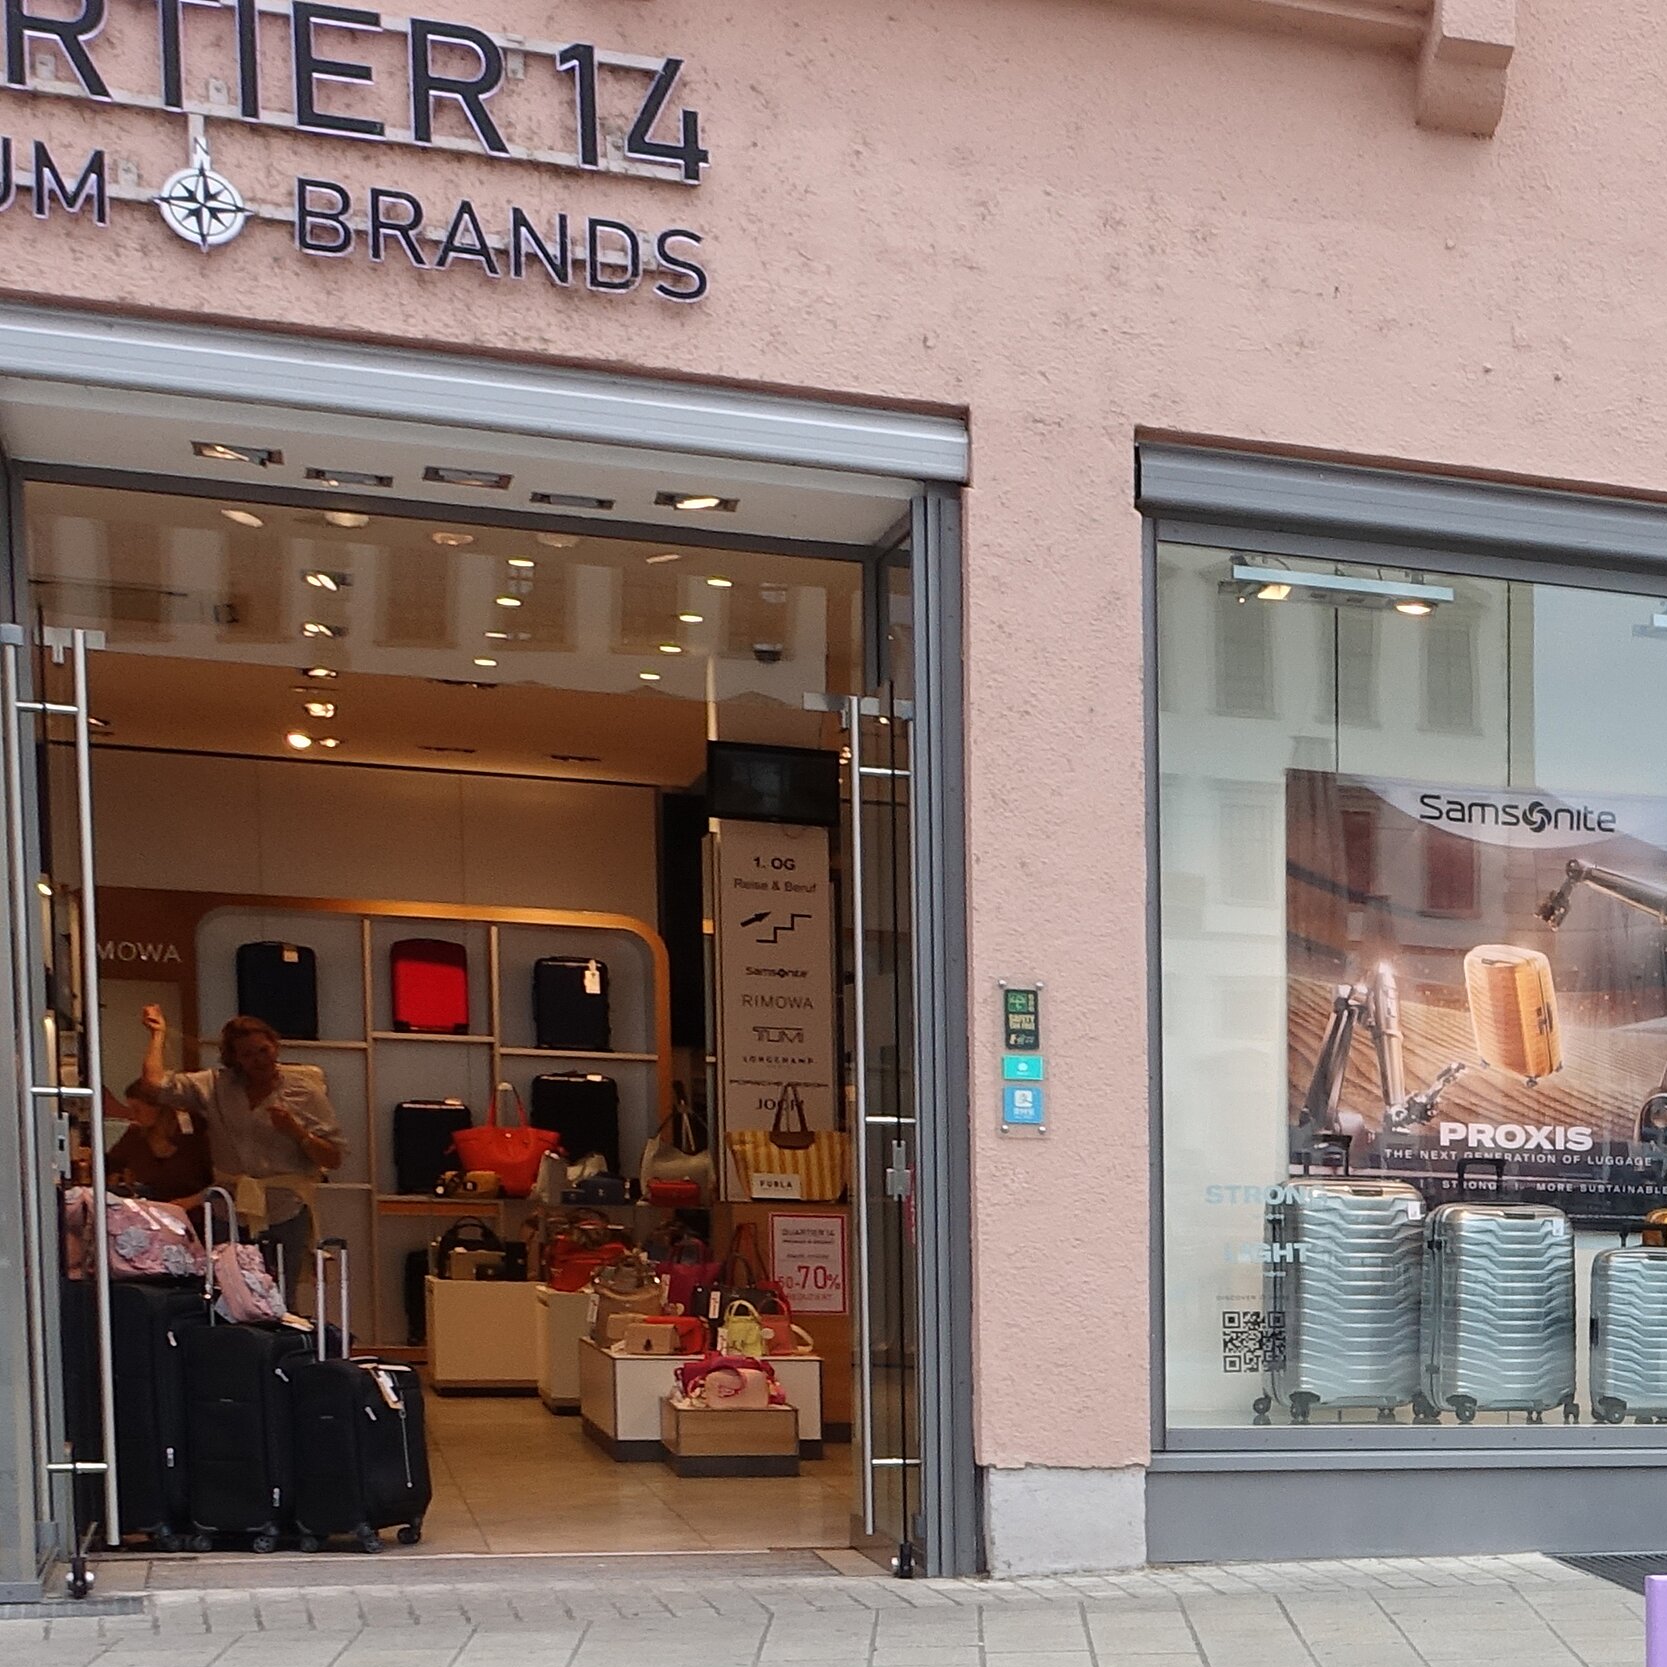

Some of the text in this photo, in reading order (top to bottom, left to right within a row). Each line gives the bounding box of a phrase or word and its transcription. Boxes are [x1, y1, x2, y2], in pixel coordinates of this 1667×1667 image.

[556, 42, 710, 186] 14
[294, 177, 709, 303] BRANDS
[1419, 793, 1617, 833] Samsonite
[771, 857, 796, 871] OG
[97, 940, 183, 962] MOWA
[741, 993, 815, 1010] RIMOWA
[1439, 1121, 1594, 1151] PROXIS
[1384, 1148, 1652, 1167] THE NEXT GENERATION OF LUGGAGE
[1536, 1182, 1573, 1192] MORE
